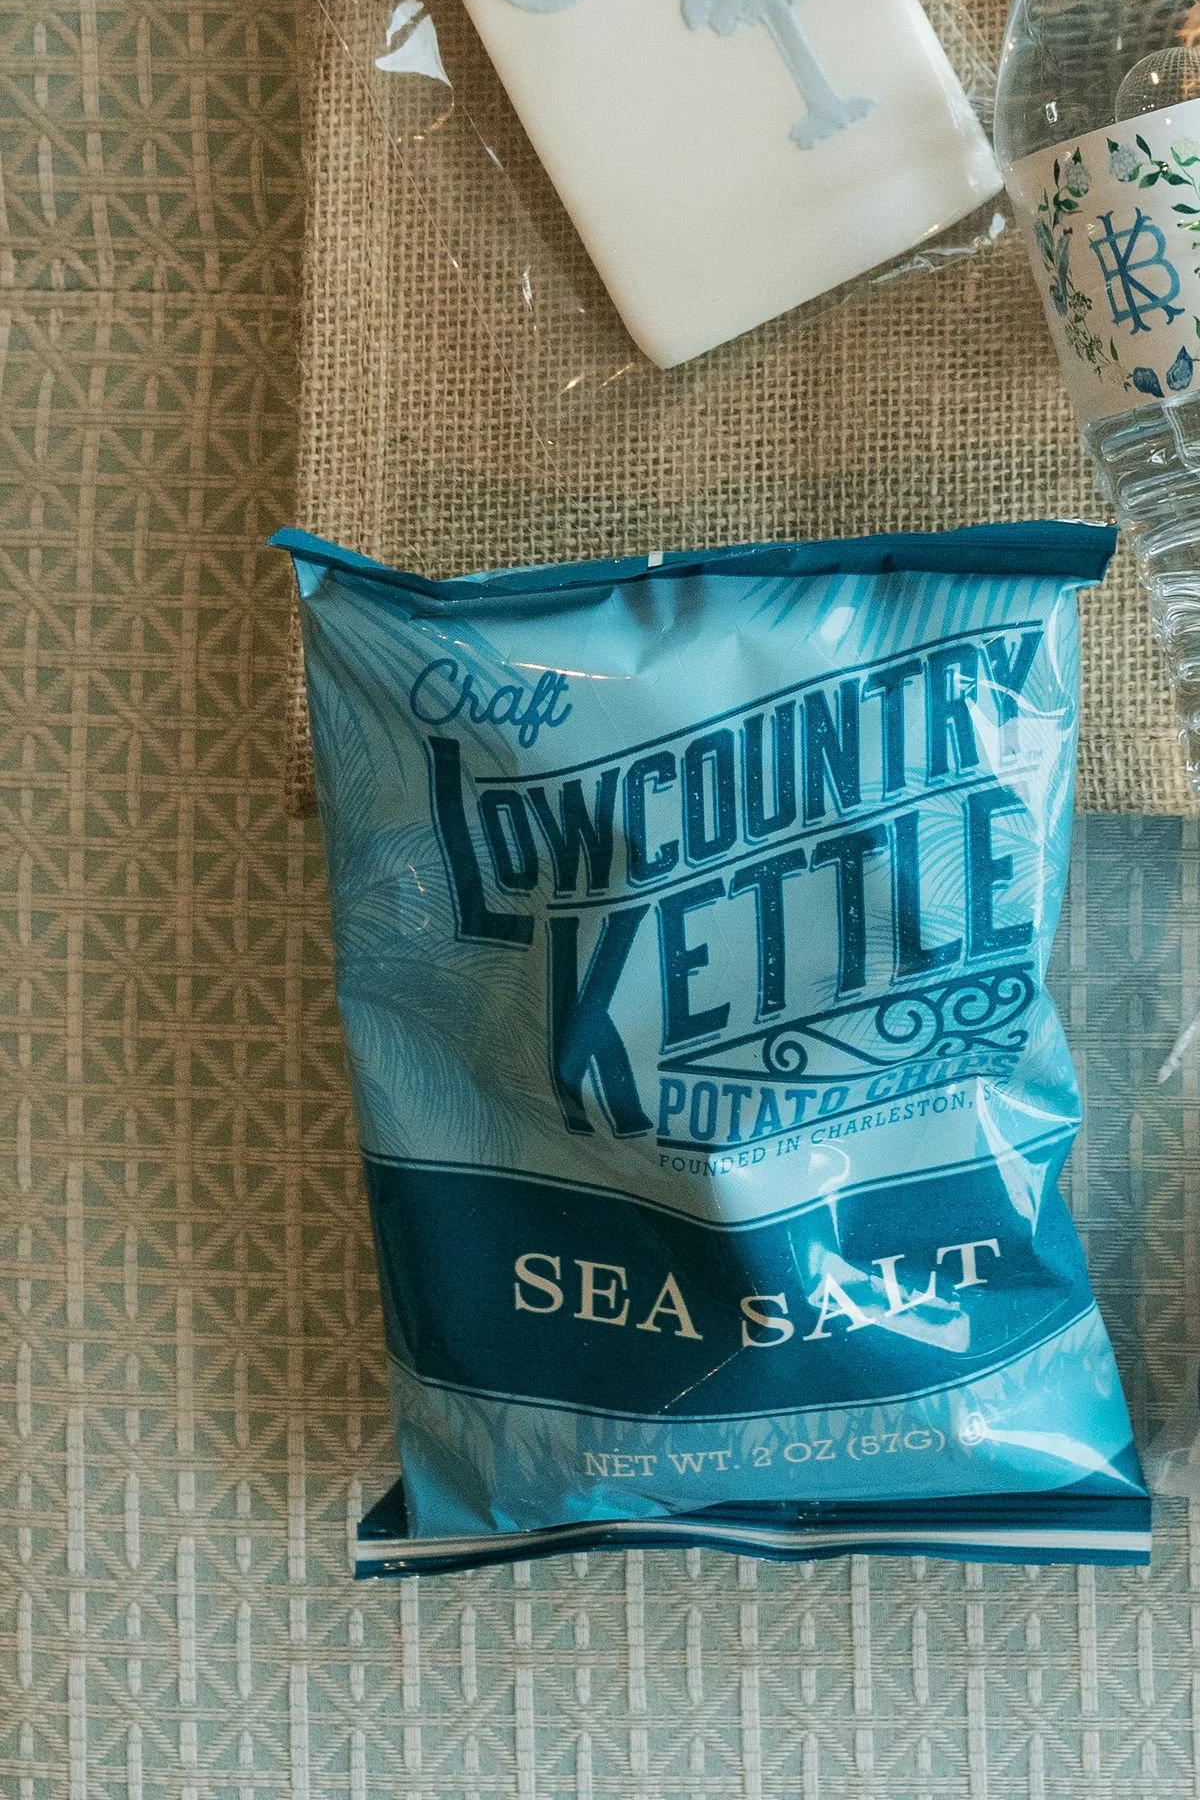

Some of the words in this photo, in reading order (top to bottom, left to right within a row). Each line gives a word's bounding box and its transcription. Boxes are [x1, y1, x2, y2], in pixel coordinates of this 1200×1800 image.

[409, 657, 573, 749] Craft
[424, 630, 1045, 952] LOWCOUNTRY
[547, 780, 1036, 1137] KETTLE
[658, 1077, 850, 1143] POTATO
[865, 1054, 1020, 1101] CHIPS
[659, 1145, 766, 1178] FOUNDED
[776, 1133, 800, 1157] IN
[809, 1090, 973, 1145] CHARLESTON,
[514, 1251, 703, 1341] SEA
[739, 1237, 1002, 1349] SALT
[584, 1451, 656, 1478] NET
[670, 1449, 740, 1475] WT.
[752, 1445, 772, 1469] 2
[783, 1440, 837, 1466] OZ
[846, 1429, 946, 1463] (57G)
